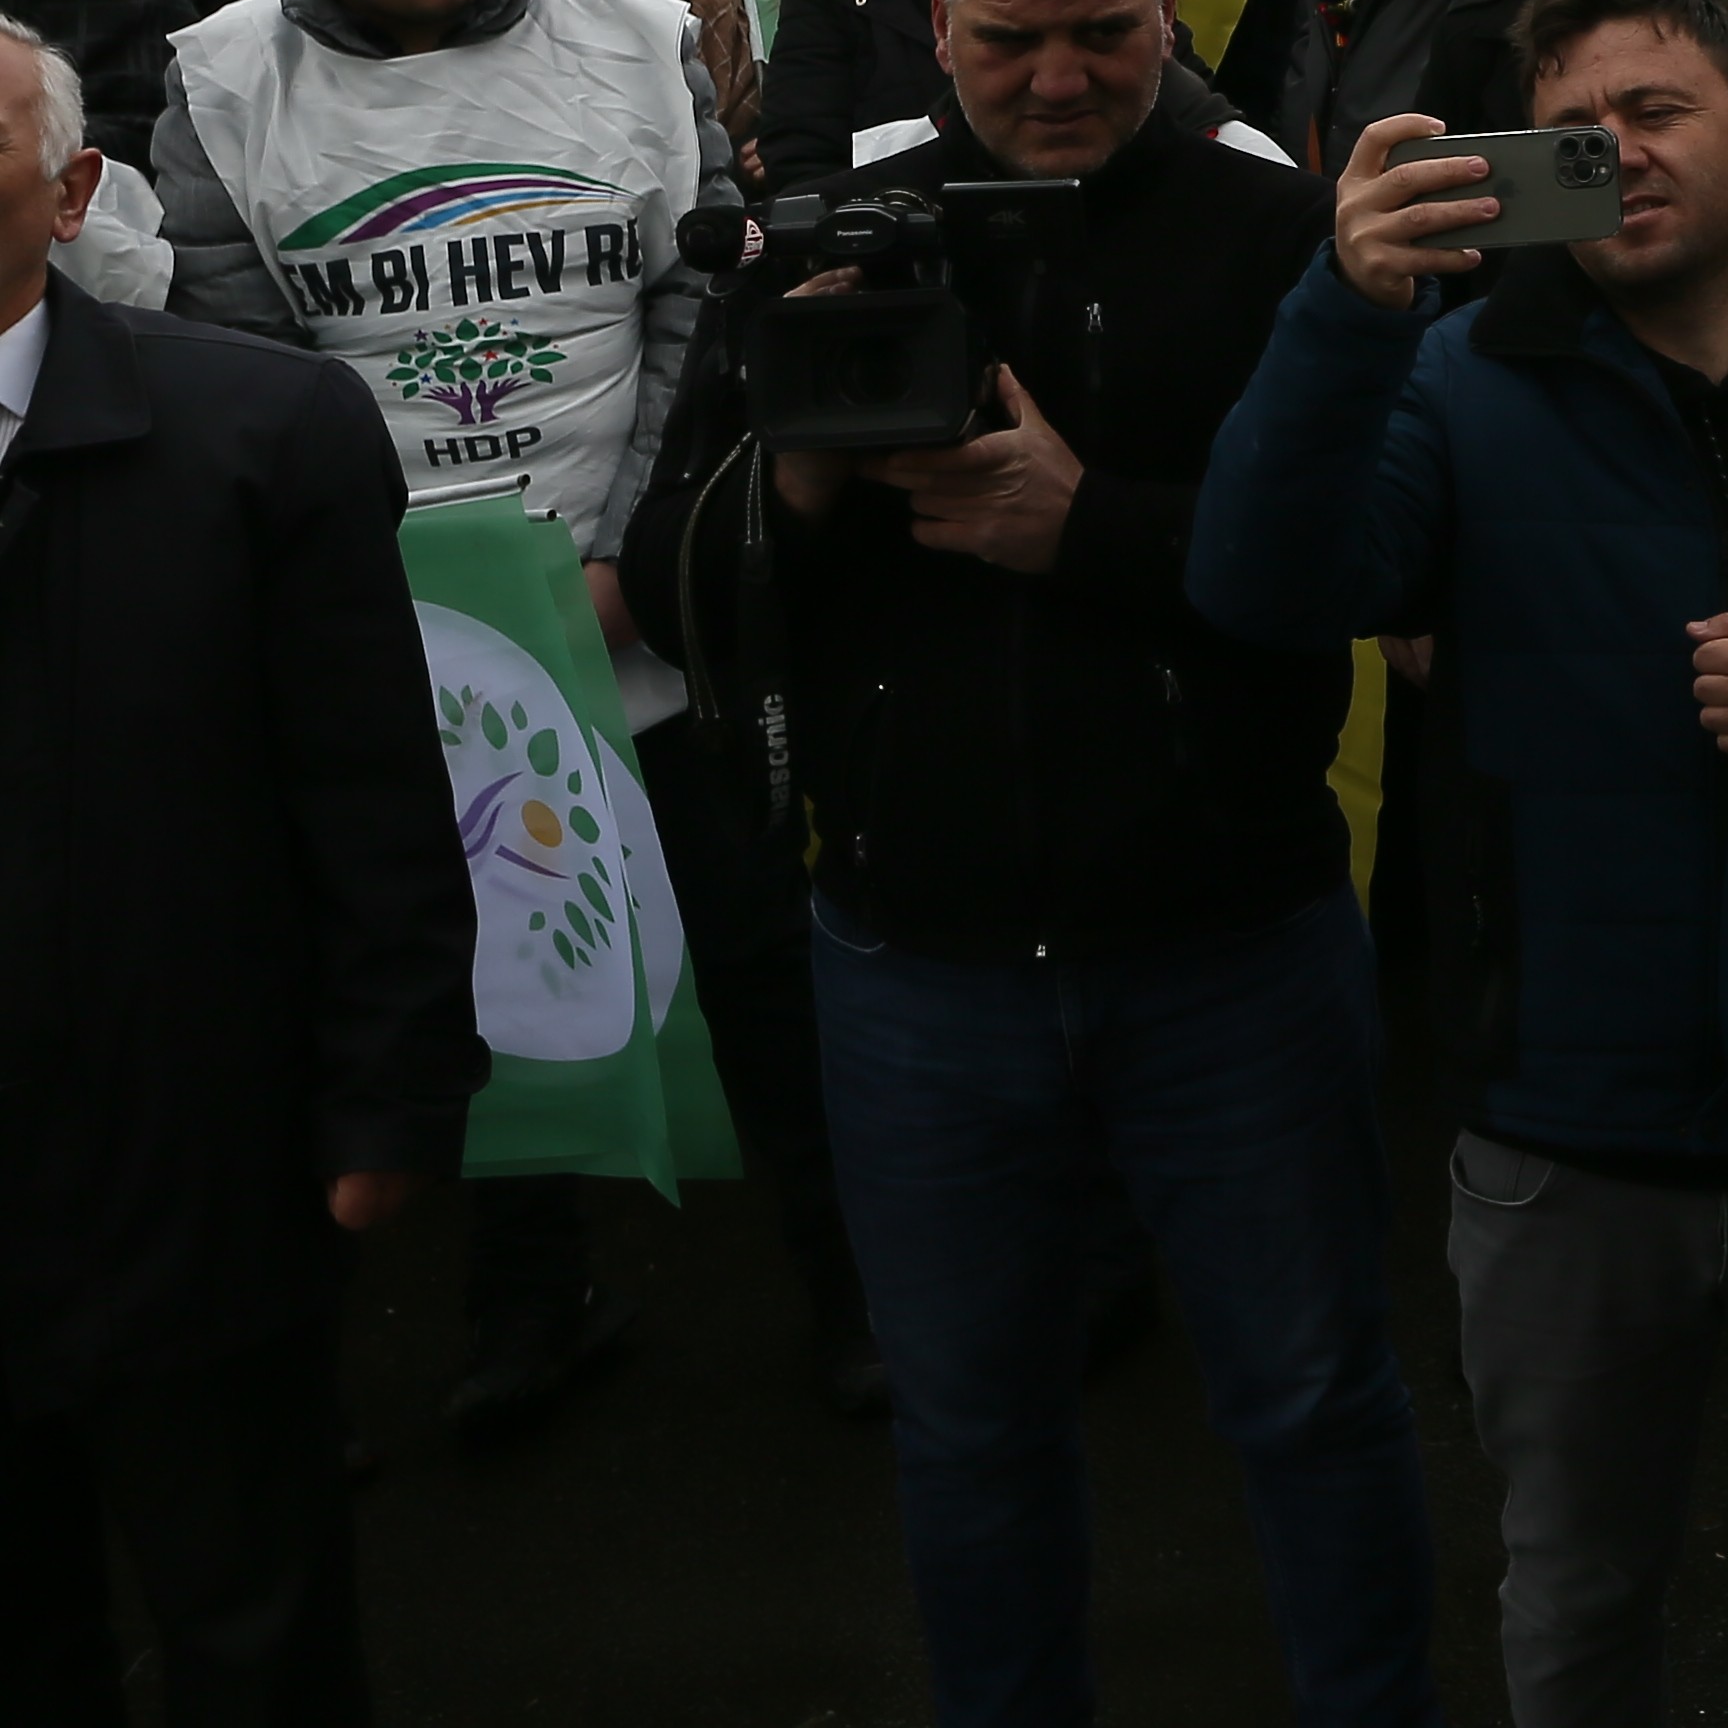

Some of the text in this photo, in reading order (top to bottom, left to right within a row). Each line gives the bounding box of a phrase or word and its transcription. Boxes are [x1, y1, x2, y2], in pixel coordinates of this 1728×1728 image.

[837, 229, 873, 237] Panasonic
[371, 244, 430, 314] BI
[447, 229, 565, 307] HEV
[423, 425, 543, 468] HDP
